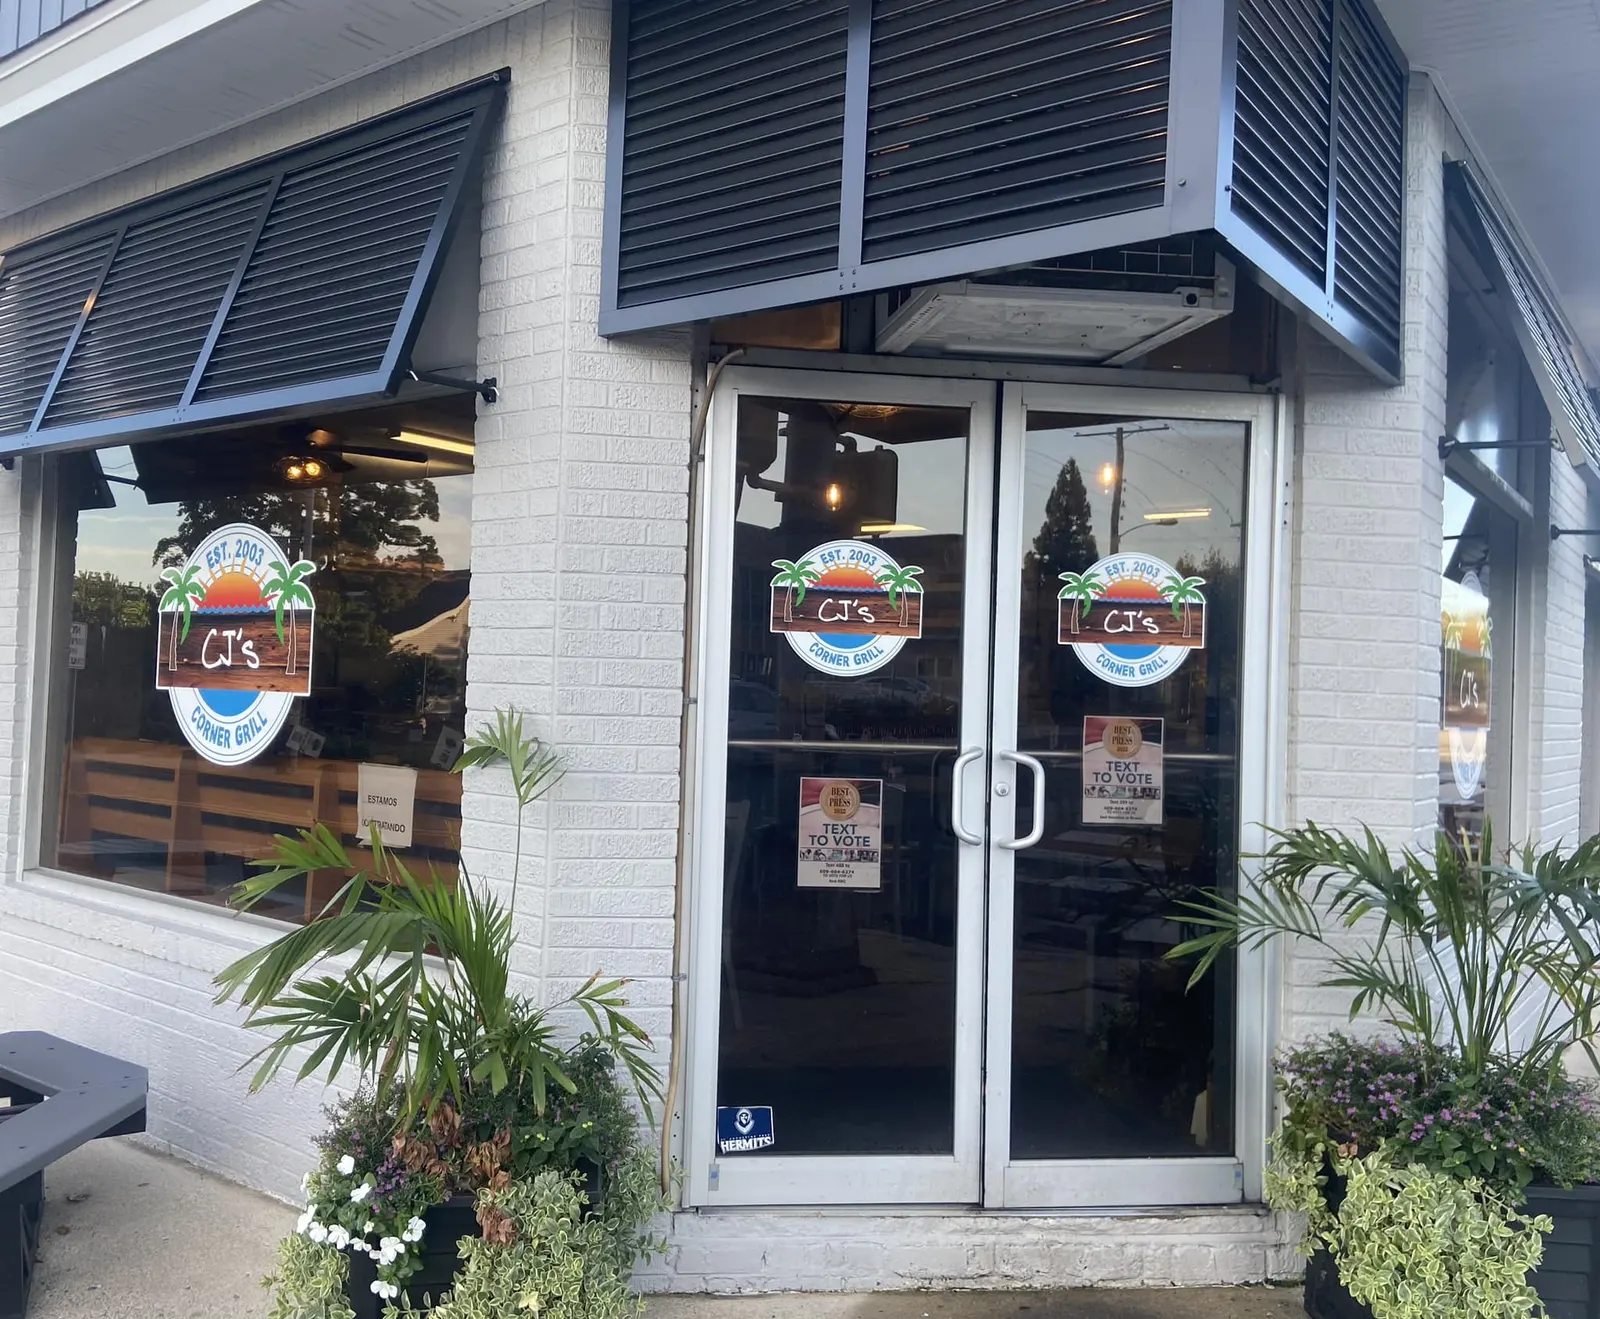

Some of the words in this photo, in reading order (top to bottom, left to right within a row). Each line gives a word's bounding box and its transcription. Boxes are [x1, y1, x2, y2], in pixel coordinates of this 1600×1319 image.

[206, 543, 231, 569] EST.
[236, 539, 265, 566] 2003
[820, 549, 845, 565] EST.
[850, 549, 877, 567] 2003
[1105, 562, 1130, 576] EST.
[1133, 561, 1161, 578] 2003
[818, 598, 875, 623] CJ's
[1104, 609, 1160, 634] CJ's
[201, 627, 260, 669] CJ's
[809, 642, 850, 667] CORNER
[853, 645, 884, 665] GRILL
[1095, 653, 1136, 678] CORNER
[1139, 655, 1168, 676] GRILL
[1459, 669, 1479, 709] CJ's
[191, 706, 231, 749] CORNER
[235, 711, 268, 746] GRILL
[1113, 725, 1132, 735] BEST
[1111, 736, 1133, 745] PRESS
[1105, 761, 1140, 773] TEXT
[1092, 772, 1112, 783] TO
[1116, 773, 1153, 784] VOTE
[831, 787, 850, 796] BEST
[367, 795, 398, 807] ESTAMOS
[829, 798, 851, 807] PRESS
[823, 823, 858, 835] TEXT
[808, 835, 828, 846] TO
[833, 836, 871, 847] VOTE
[720, 1136, 771, 1153] HERMITS
